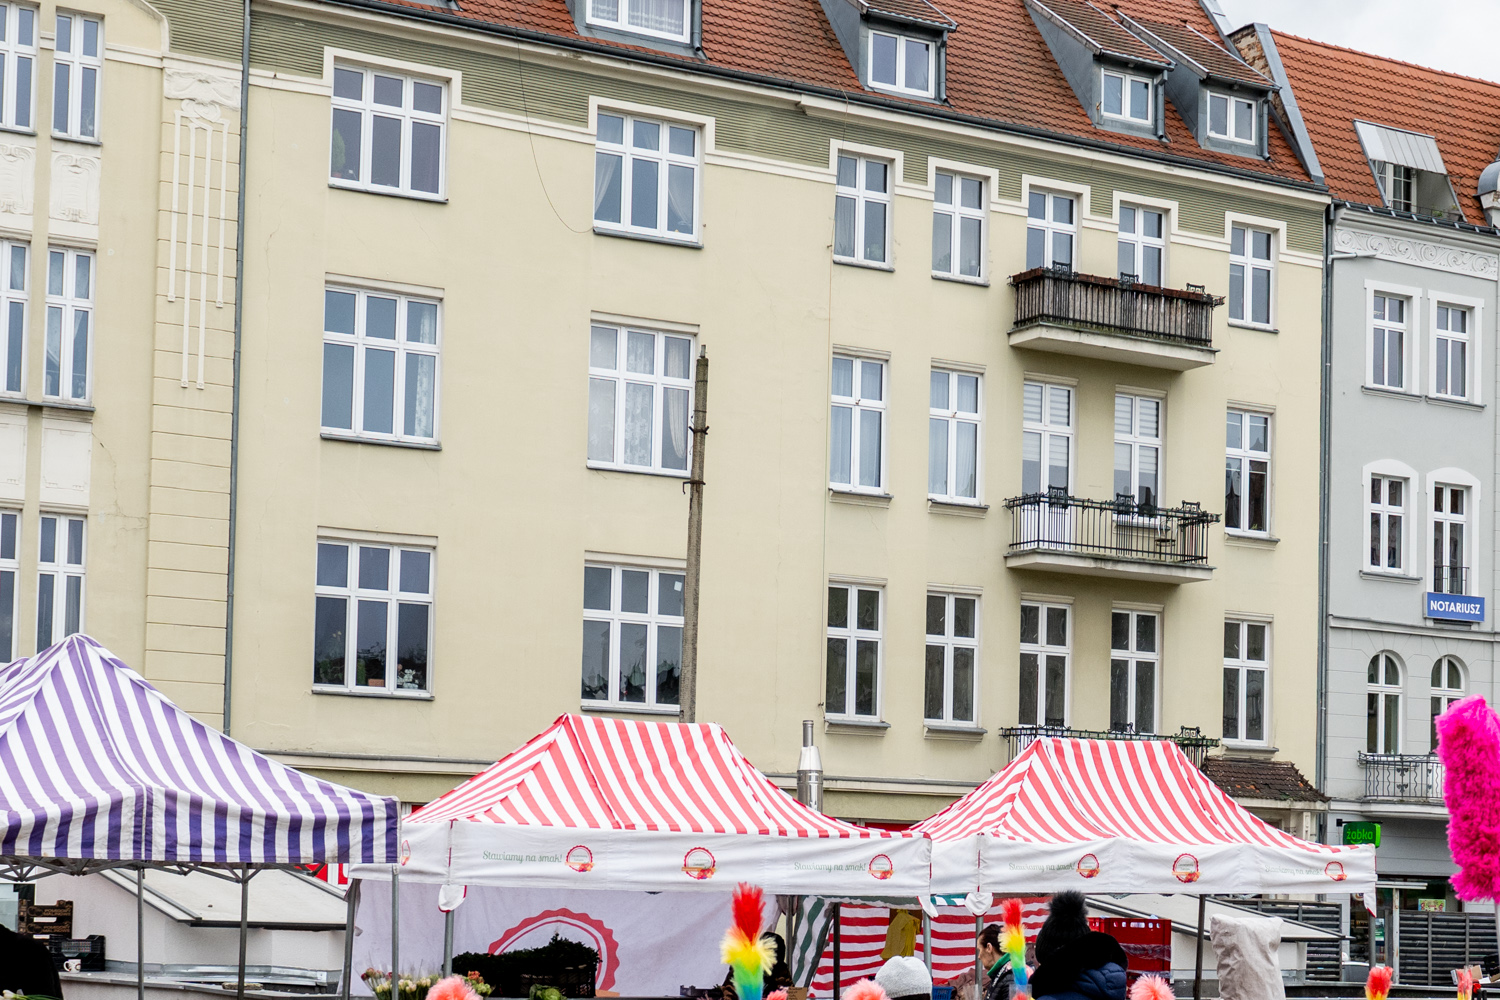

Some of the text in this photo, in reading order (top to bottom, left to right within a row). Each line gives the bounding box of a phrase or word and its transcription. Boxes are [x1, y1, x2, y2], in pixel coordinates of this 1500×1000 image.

[1430, 600, 1481, 614] NOTARIUSZ
[1346, 828, 1374, 840] żabka
[482, 850, 524, 863] Stawiamy
[525, 855, 537, 863] na
[538, 854, 563, 863] smak!
